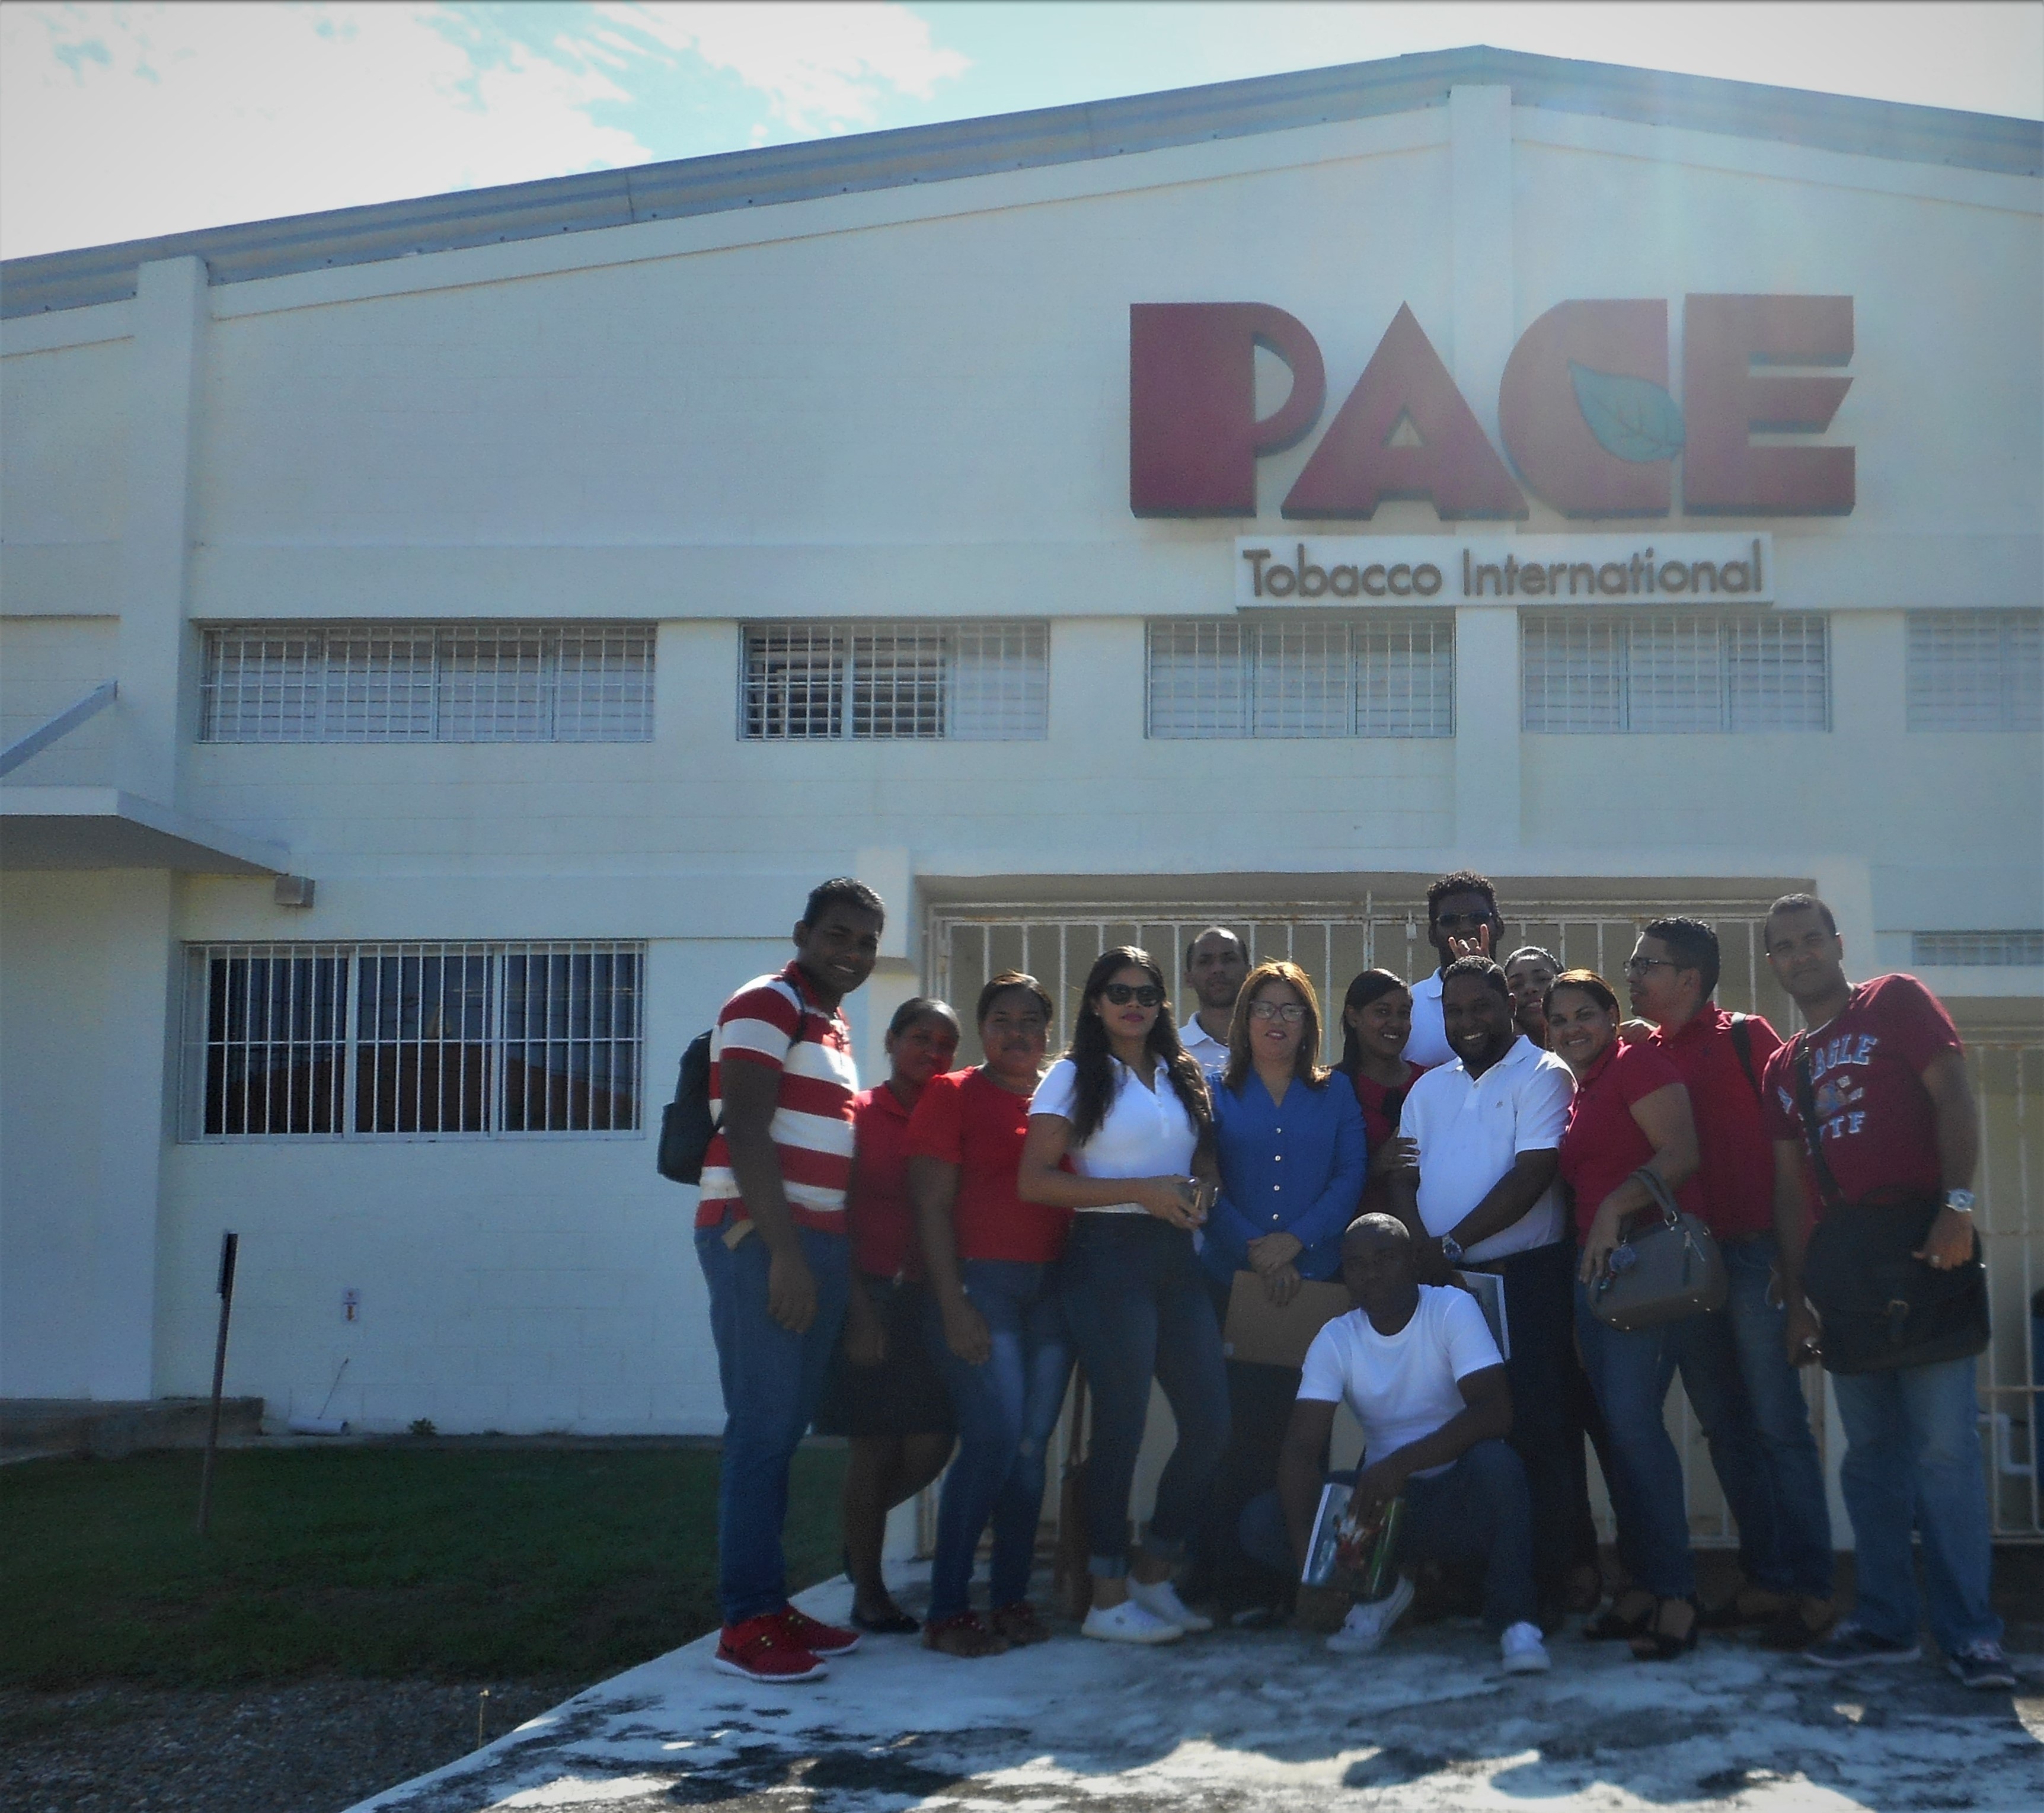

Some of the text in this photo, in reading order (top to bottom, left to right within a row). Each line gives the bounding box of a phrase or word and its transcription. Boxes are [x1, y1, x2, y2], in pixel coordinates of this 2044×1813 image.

[1130, 293, 1855, 520] PACE
[1243, 539, 1762, 597] Tobacco International
[1809, 1033, 1878, 1085] AGLE
